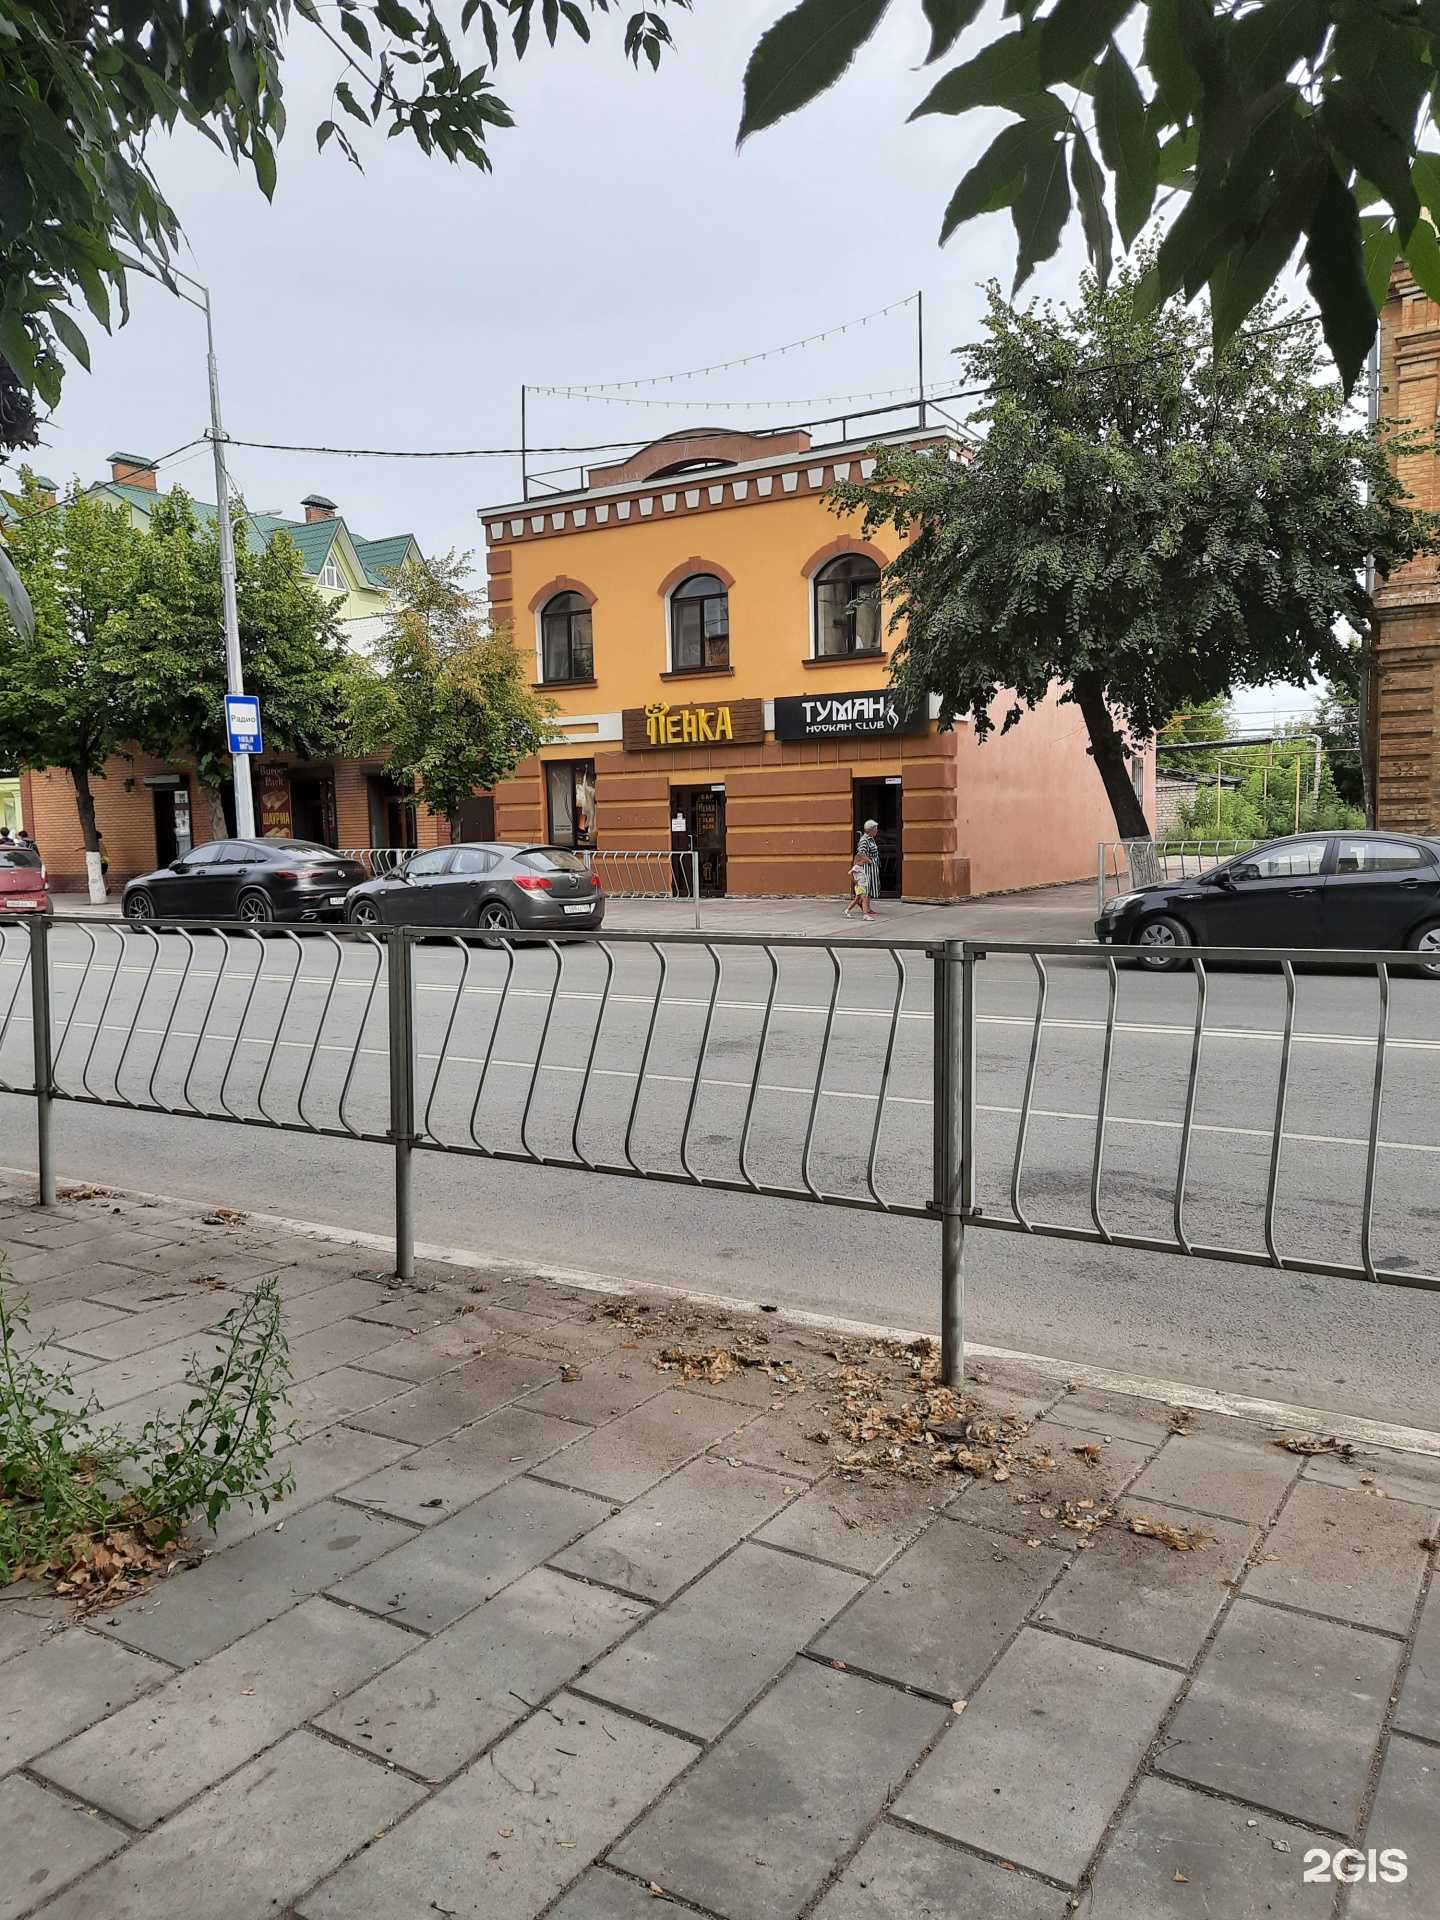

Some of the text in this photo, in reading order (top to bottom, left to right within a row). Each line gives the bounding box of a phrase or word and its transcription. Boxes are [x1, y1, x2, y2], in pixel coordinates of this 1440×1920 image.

[801, 696, 885, 723] ТУМАН
[231, 714, 256, 723] Радио
[645, 702, 733, 745] ПЕНКА
[806, 720, 885, 733] HOOKAH CLUB
[262, 811, 291, 825] ШАУРМА
